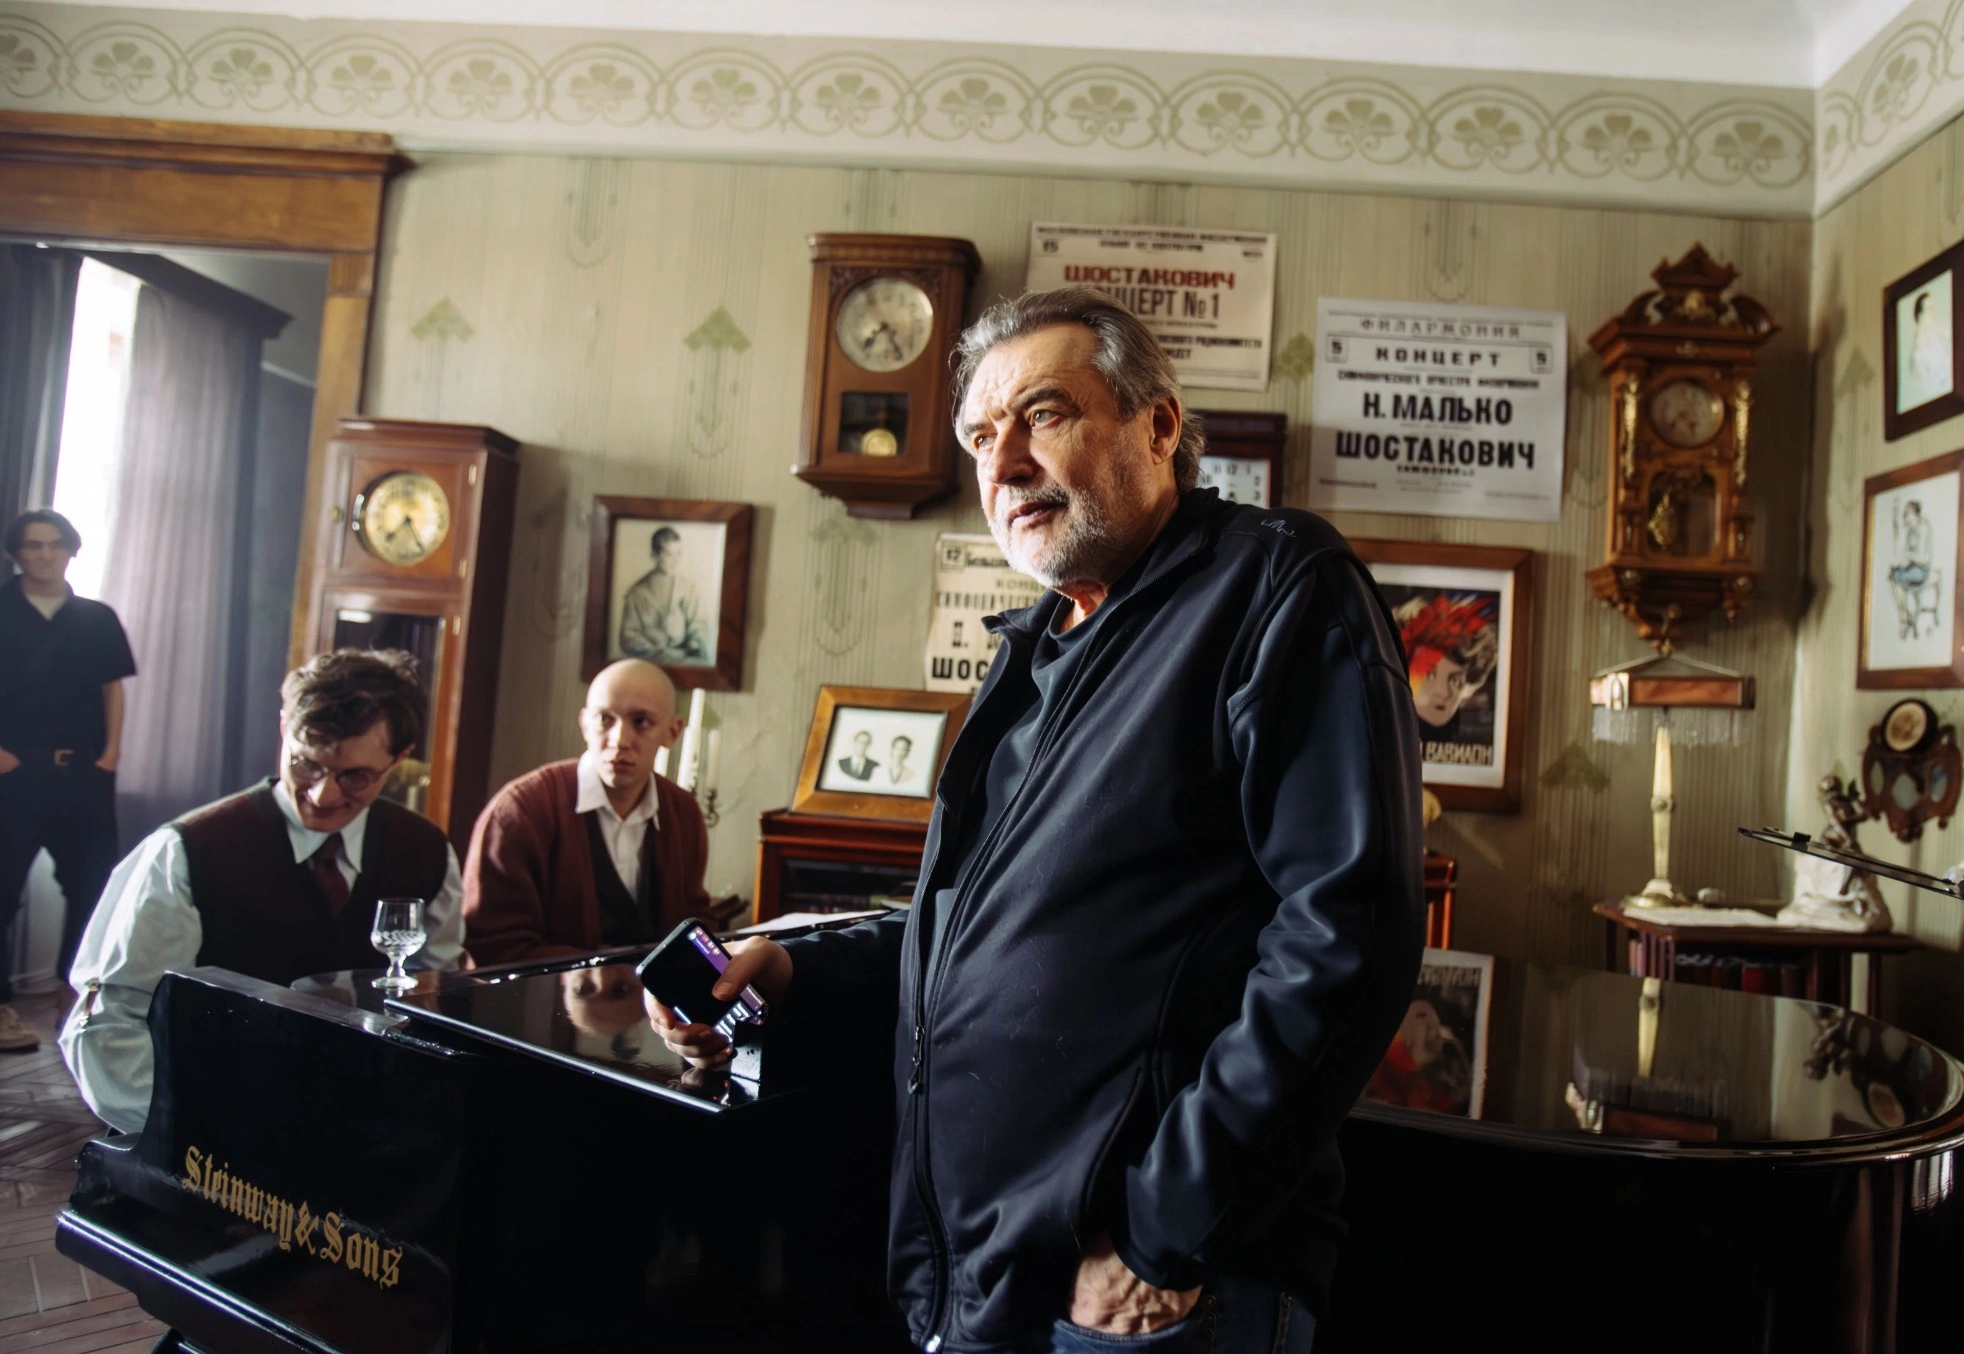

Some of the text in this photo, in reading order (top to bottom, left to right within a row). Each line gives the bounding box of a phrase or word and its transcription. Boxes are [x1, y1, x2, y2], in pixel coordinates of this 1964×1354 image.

[1064, 265, 1235, 289] ШОСТАКОВИЧ
[1360, 318, 1520, 339] ФИЛАРМОНИЯ
[1376, 347, 1501, 367] КОНЦЕРТ
[1363, 392, 1513, 425] Н. МАЛЬКО
[1335, 431, 1535, 469] ШОСТАКОВИЧ
[320, 1211, 403, 1290] Sons
